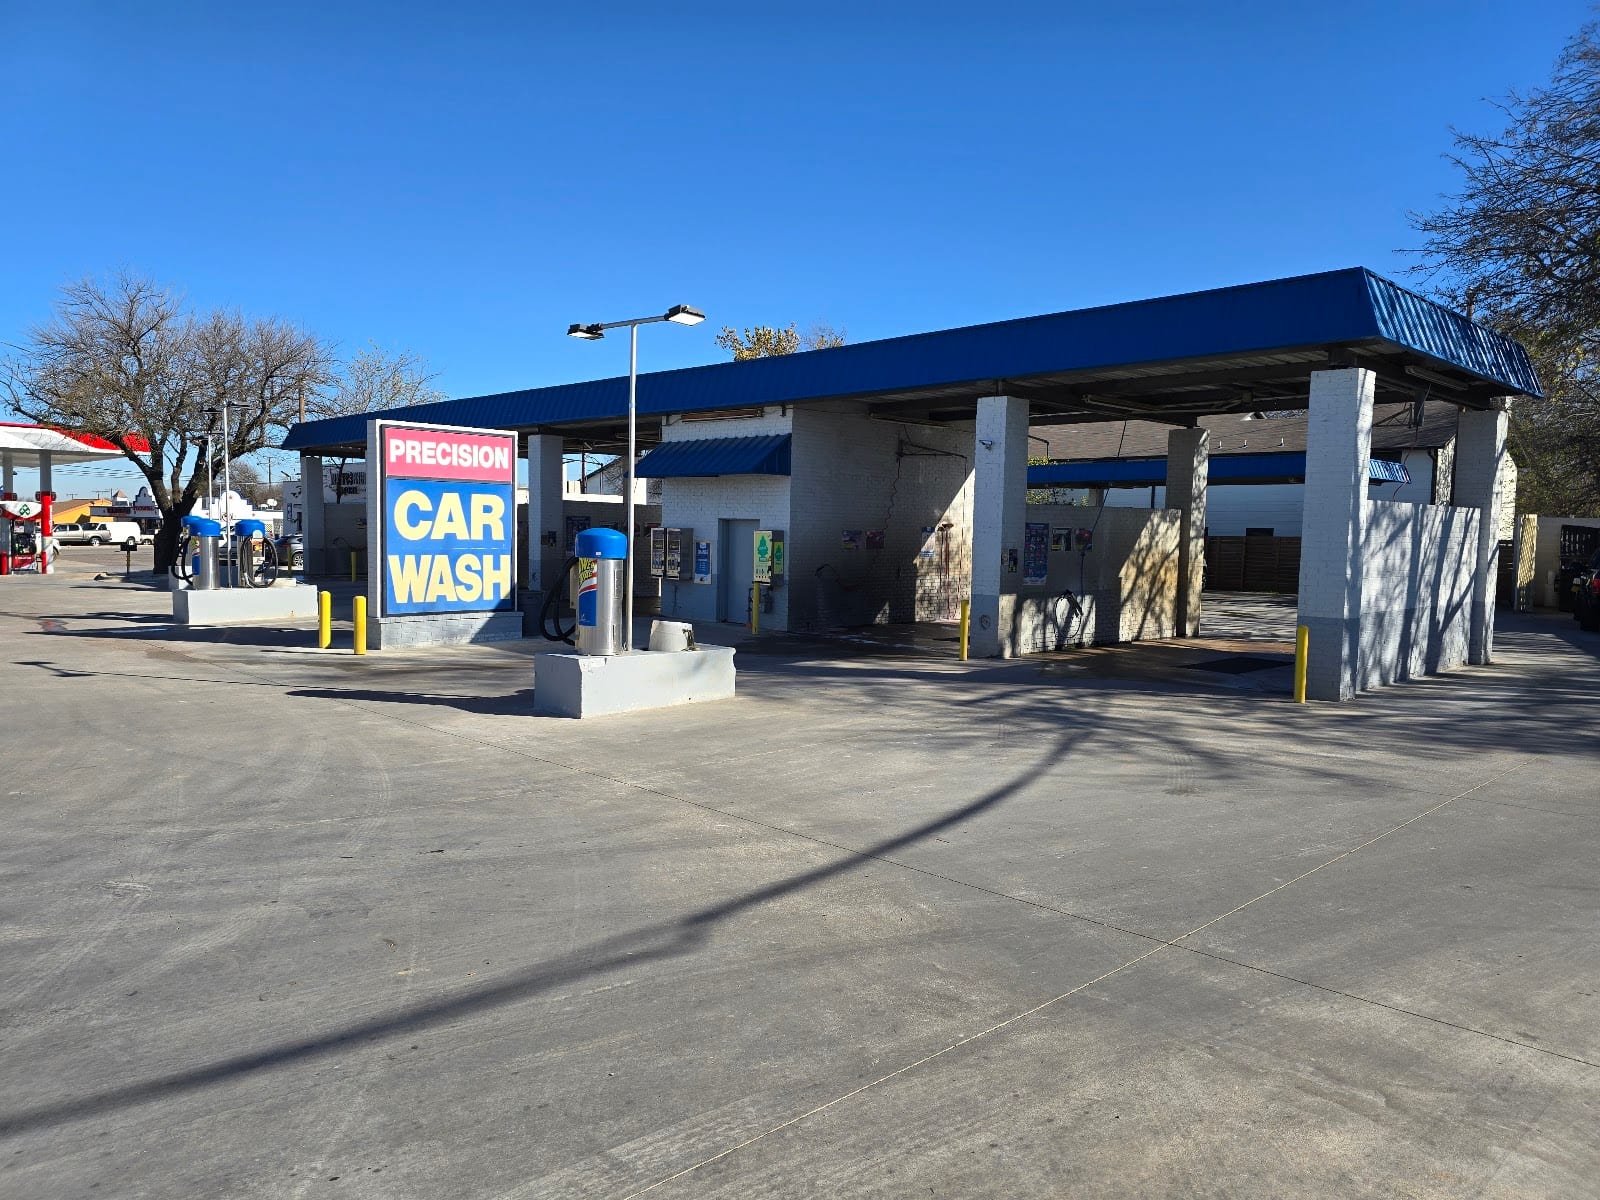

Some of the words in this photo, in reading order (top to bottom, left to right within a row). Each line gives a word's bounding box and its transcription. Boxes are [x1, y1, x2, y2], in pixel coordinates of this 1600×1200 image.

[389, 438, 509, 469] PRECISION
[393, 490, 505, 541] CAR
[387, 554, 511, 603] WASH
